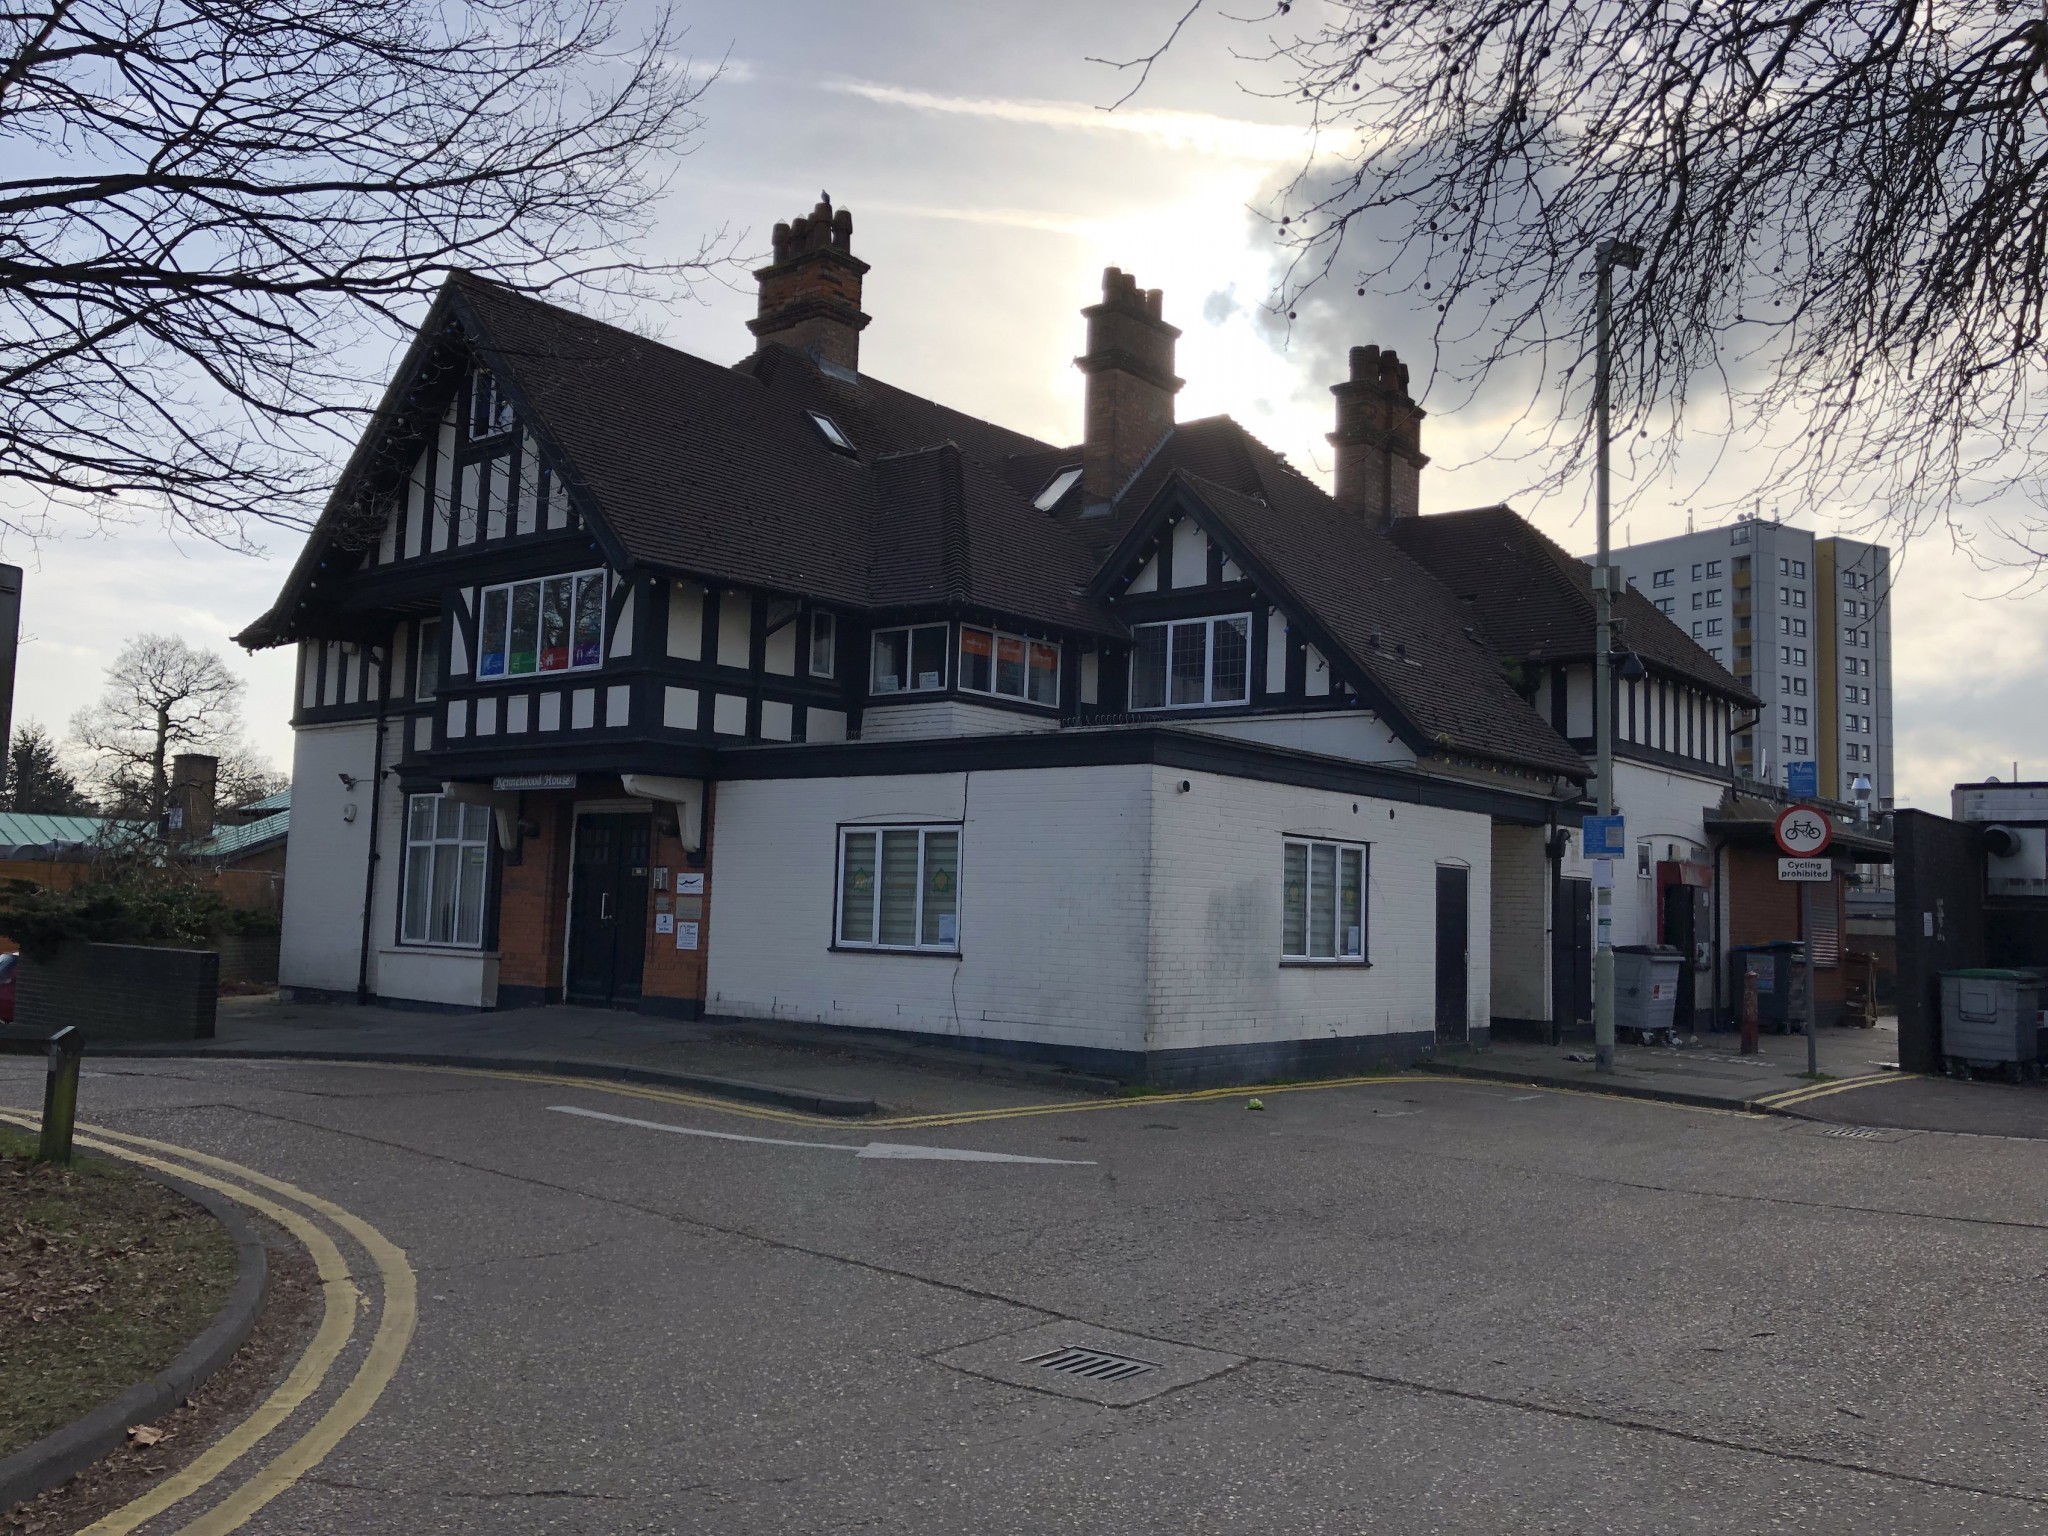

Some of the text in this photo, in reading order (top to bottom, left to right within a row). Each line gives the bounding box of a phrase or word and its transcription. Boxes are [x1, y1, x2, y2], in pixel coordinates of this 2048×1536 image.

[544, 774, 573, 786] House
[1788, 861, 1822, 870] Cycling
[1781, 870, 1828, 878] prohibited
